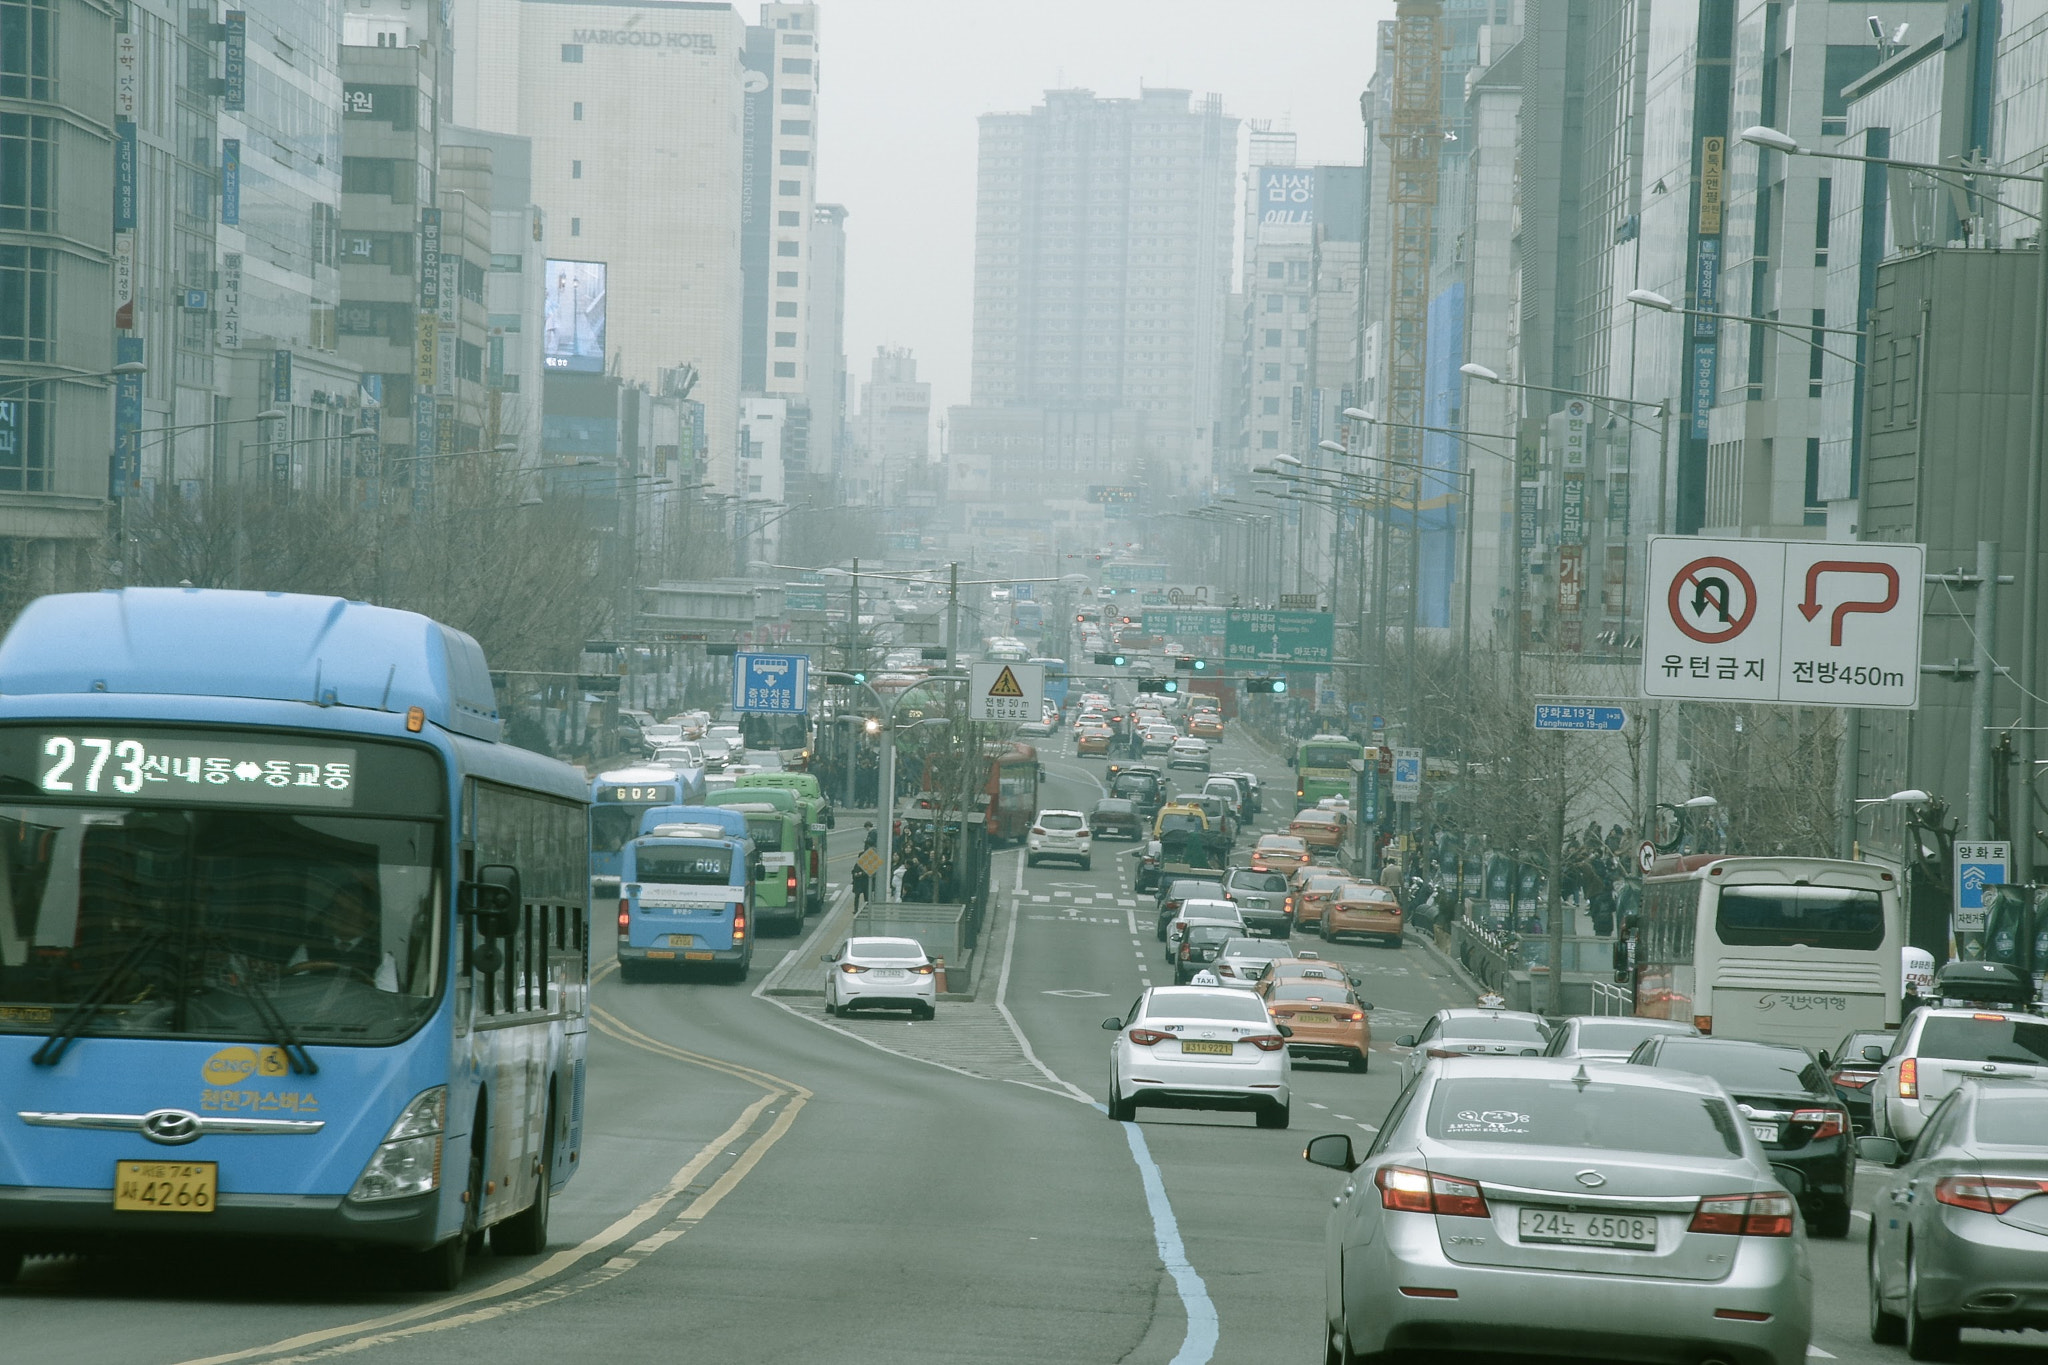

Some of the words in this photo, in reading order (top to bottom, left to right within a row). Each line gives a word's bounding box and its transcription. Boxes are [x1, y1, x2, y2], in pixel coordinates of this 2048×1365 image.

[573, 29, 661, 46] MARIGOLD
[666, 33, 716, 48] HOTEL
[119, 37, 134, 112] 유학닷컴
[743, 96, 755, 133] HOTEL
[743, 139, 754, 161] THE
[1266, 174, 1313, 203] 삼성
[1705, 154, 1720, 203] 톡스앤필
[741, 163, 754, 224] DESIGNERS
[1264, 210, 1313, 224] 애니
[424, 225, 438, 295] 종로유학원
[119, 255, 130, 300] 한화생명
[1702, 260, 1713, 298] 정형외과
[191, 294, 201, 304] P
[224, 280, 239, 347] 제니스치과
[1568, 420, 1584, 464] 한의원
[1562, 481, 1582, 533] 산부인과
[1661, 654, 1765, 681] 유턴금지
[748, 688, 791, 699] 중앙차로
[748, 698, 791, 709] 버스전용
[985, 697, 1005, 708] 전방
[1008, 698, 1019, 708] 50
[985, 708, 1029, 718] 횡단보도
[1538, 719, 1585, 728] Yanghwa-ro
[1586, 720, 1608, 729] 19-gil
[42, 737, 145, 794] 273
[142, 754, 232, 785] 신내동
[262, 759, 351, 791] 동교동
[1959, 846, 2005, 859] 양화로
[696, 859, 721, 873] 603
[1780, 994, 1846, 1010] 길벗여행
[1208, 1043, 1229, 1053] 9221
[208, 1058, 252, 1073] CNG
[201, 1088, 320, 1113] 천연가스버스
[170, 1165, 193, 1178] 74
[140, 1181, 211, 1208] 4266
[1532, 1213, 1576, 1236] 24노
[1587, 1214, 1645, 1241] 6508
[1448, 1234, 1487, 1247] SM5
